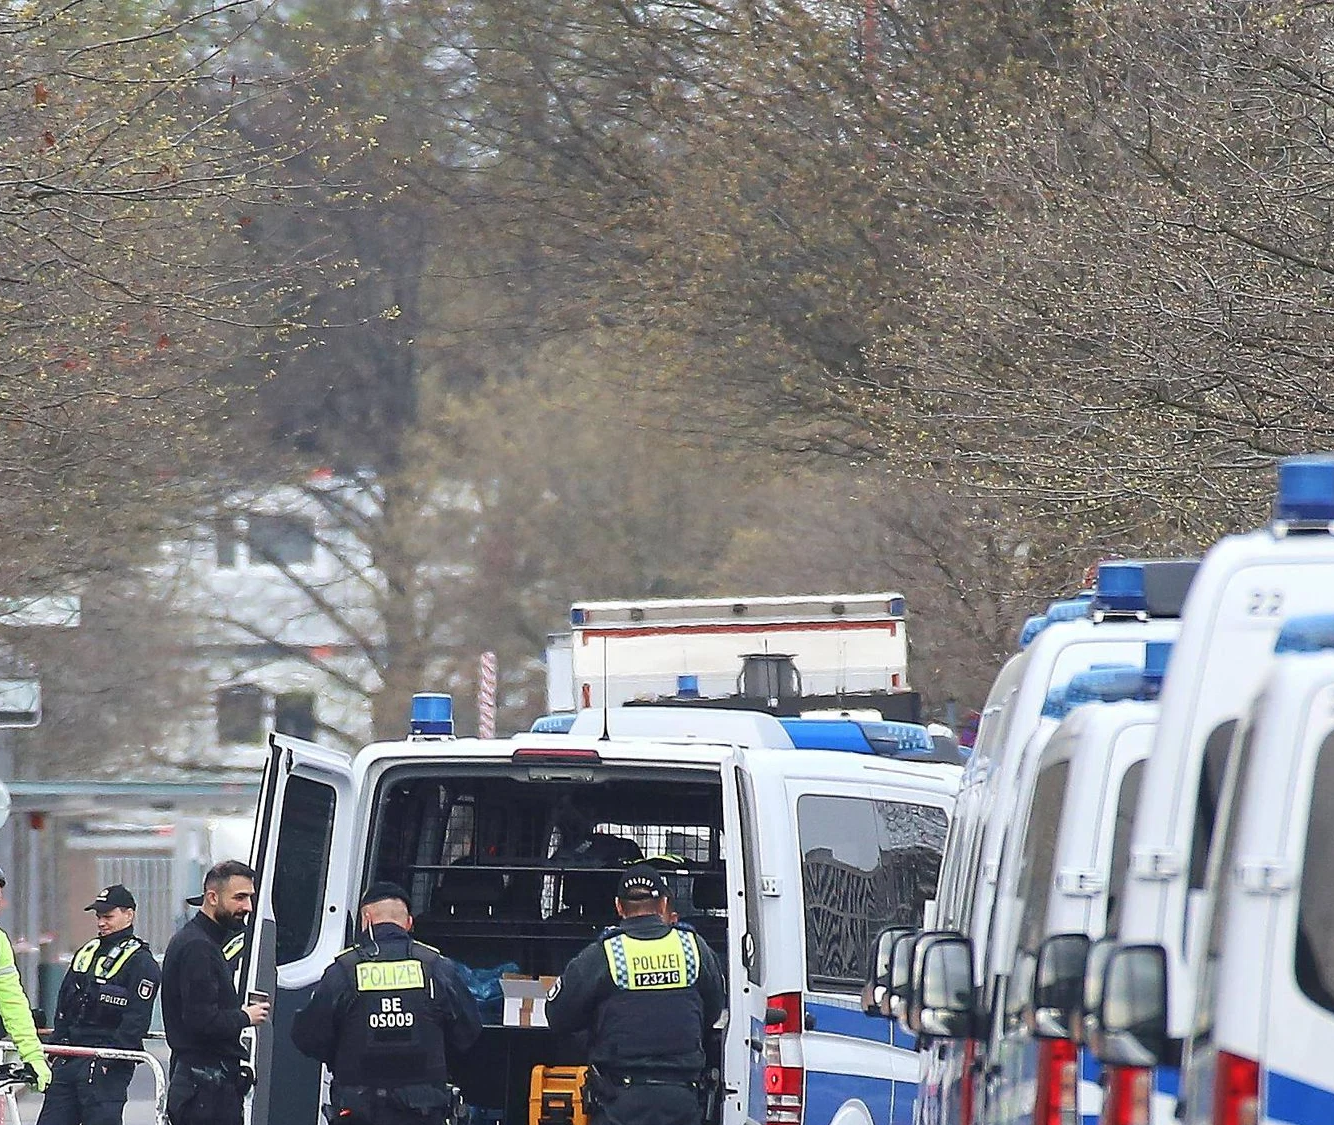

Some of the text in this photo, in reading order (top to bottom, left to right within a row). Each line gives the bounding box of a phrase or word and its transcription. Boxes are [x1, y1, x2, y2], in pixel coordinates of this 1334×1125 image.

[632, 953, 681, 971] POLIZEI
[360, 963, 422, 988] POLIZEI
[635, 972, 680, 986] 123216
[100, 993, 128, 1006] POLIZEI
[381, 997, 402, 1013] BE
